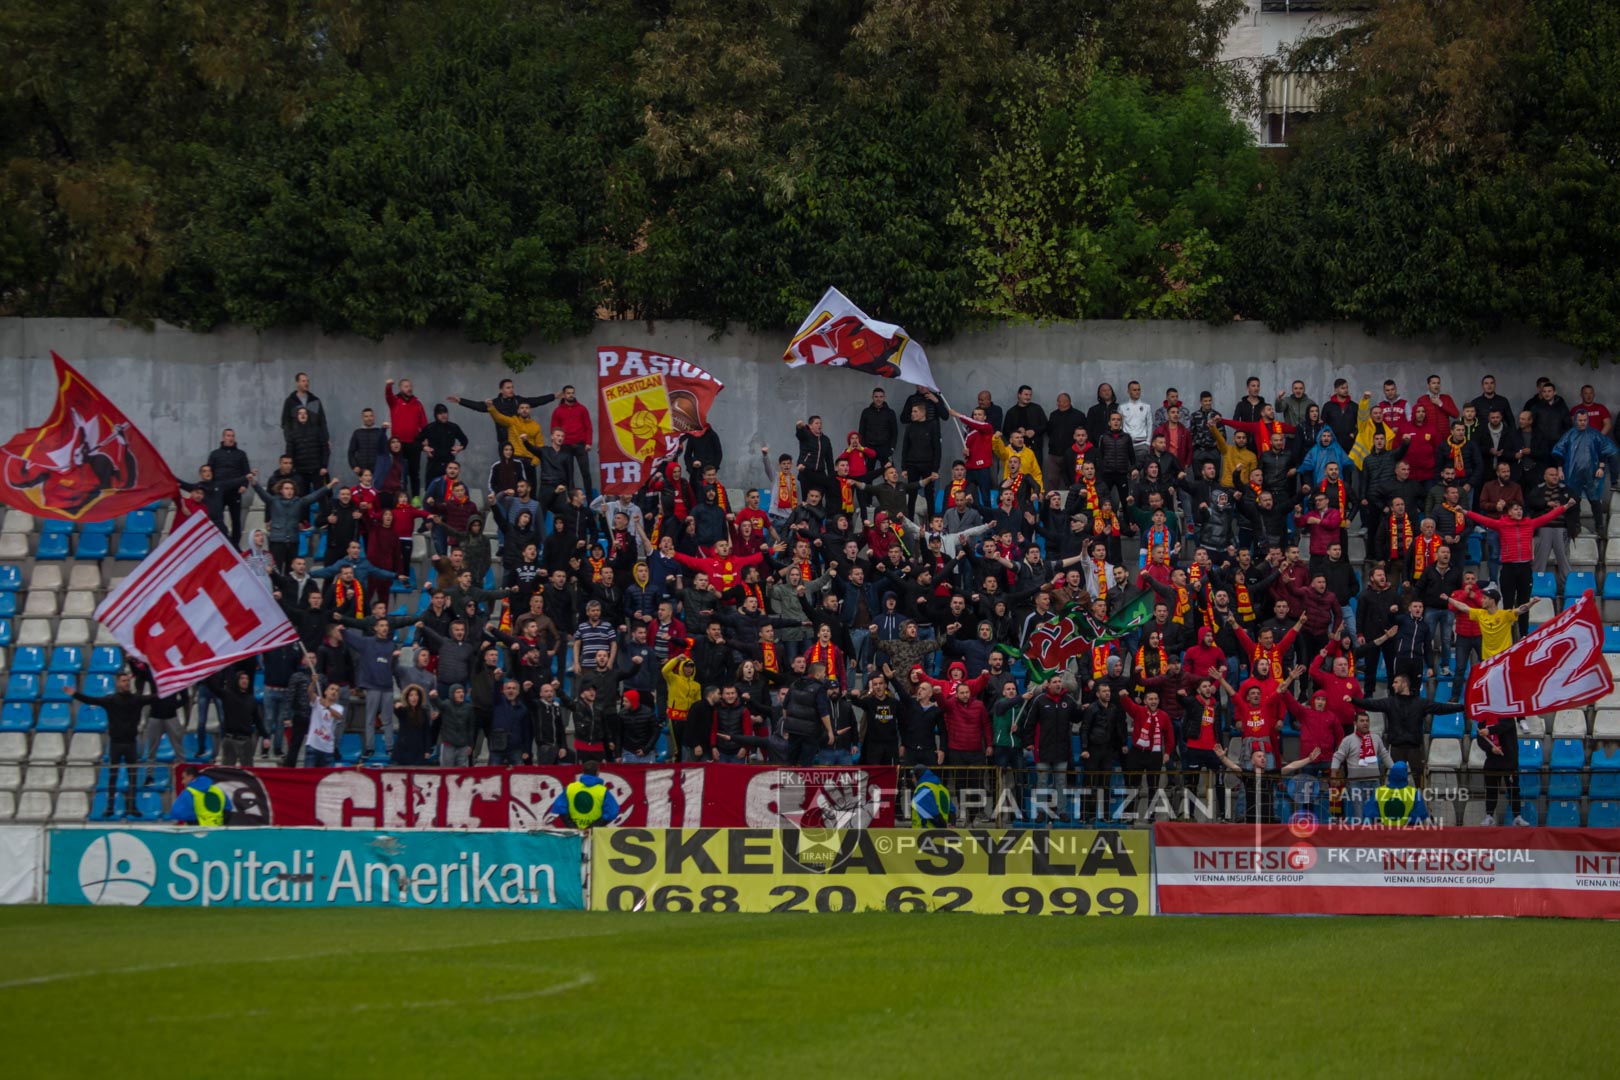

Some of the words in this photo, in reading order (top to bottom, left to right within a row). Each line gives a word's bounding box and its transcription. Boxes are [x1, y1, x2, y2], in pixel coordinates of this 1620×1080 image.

[1471, 619, 1610, 716] 12
[608, 828, 888, 875] SKELA
[914, 829, 1138, 877] SYLA
[1193, 851, 1305, 870] INTERSIG
[1383, 852, 1496, 872] INTERSIG
[1575, 855, 1620, 875] INT
[167, 847, 315, 907] Spitali
[327, 848, 557, 904] Amerikan
[1194, 874, 1226, 883] VIENNA
[1226, 874, 1274, 883] INSURANCE
[1275, 874, 1305, 883] GROUP
[1383, 876, 1416, 884] VIENNA
[1416, 876, 1465, 884] INSURANCE
[1466, 877, 1496, 885] GROUP
[1575, 879, 1608, 888] VIENNA
[606, 884, 741, 913] 068
[768, 885, 858, 914] 20
[885, 886, 974, 913] 62
[1001, 886, 1139, 916] 999
